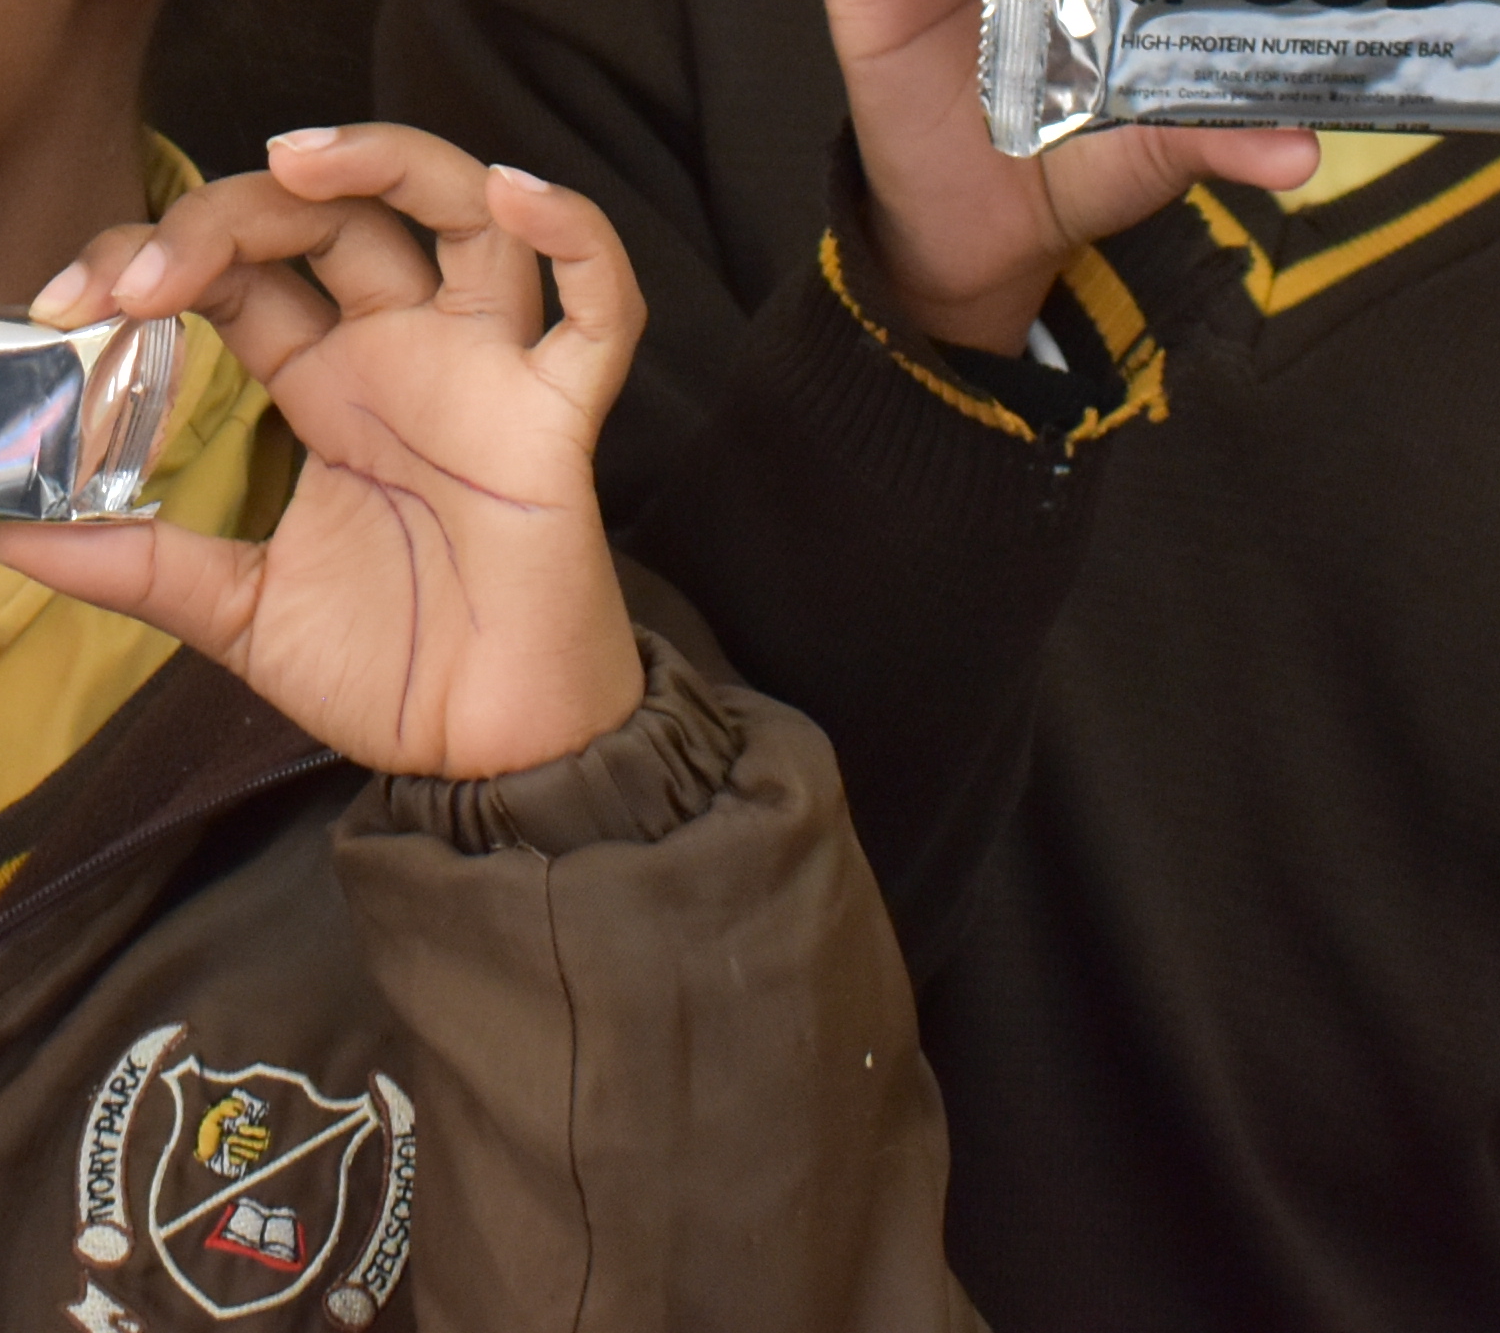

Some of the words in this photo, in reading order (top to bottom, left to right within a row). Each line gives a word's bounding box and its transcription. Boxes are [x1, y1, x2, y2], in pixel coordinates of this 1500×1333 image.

[1121, 34, 1257, 53] HIGH-PROTEIN
[1261, 36, 1350, 56] NUTRIENT
[1355, 40, 1414, 58] DENSE
[1418, 41, 1454, 58] BAR
[94, 1055, 148, 1137] PARK
